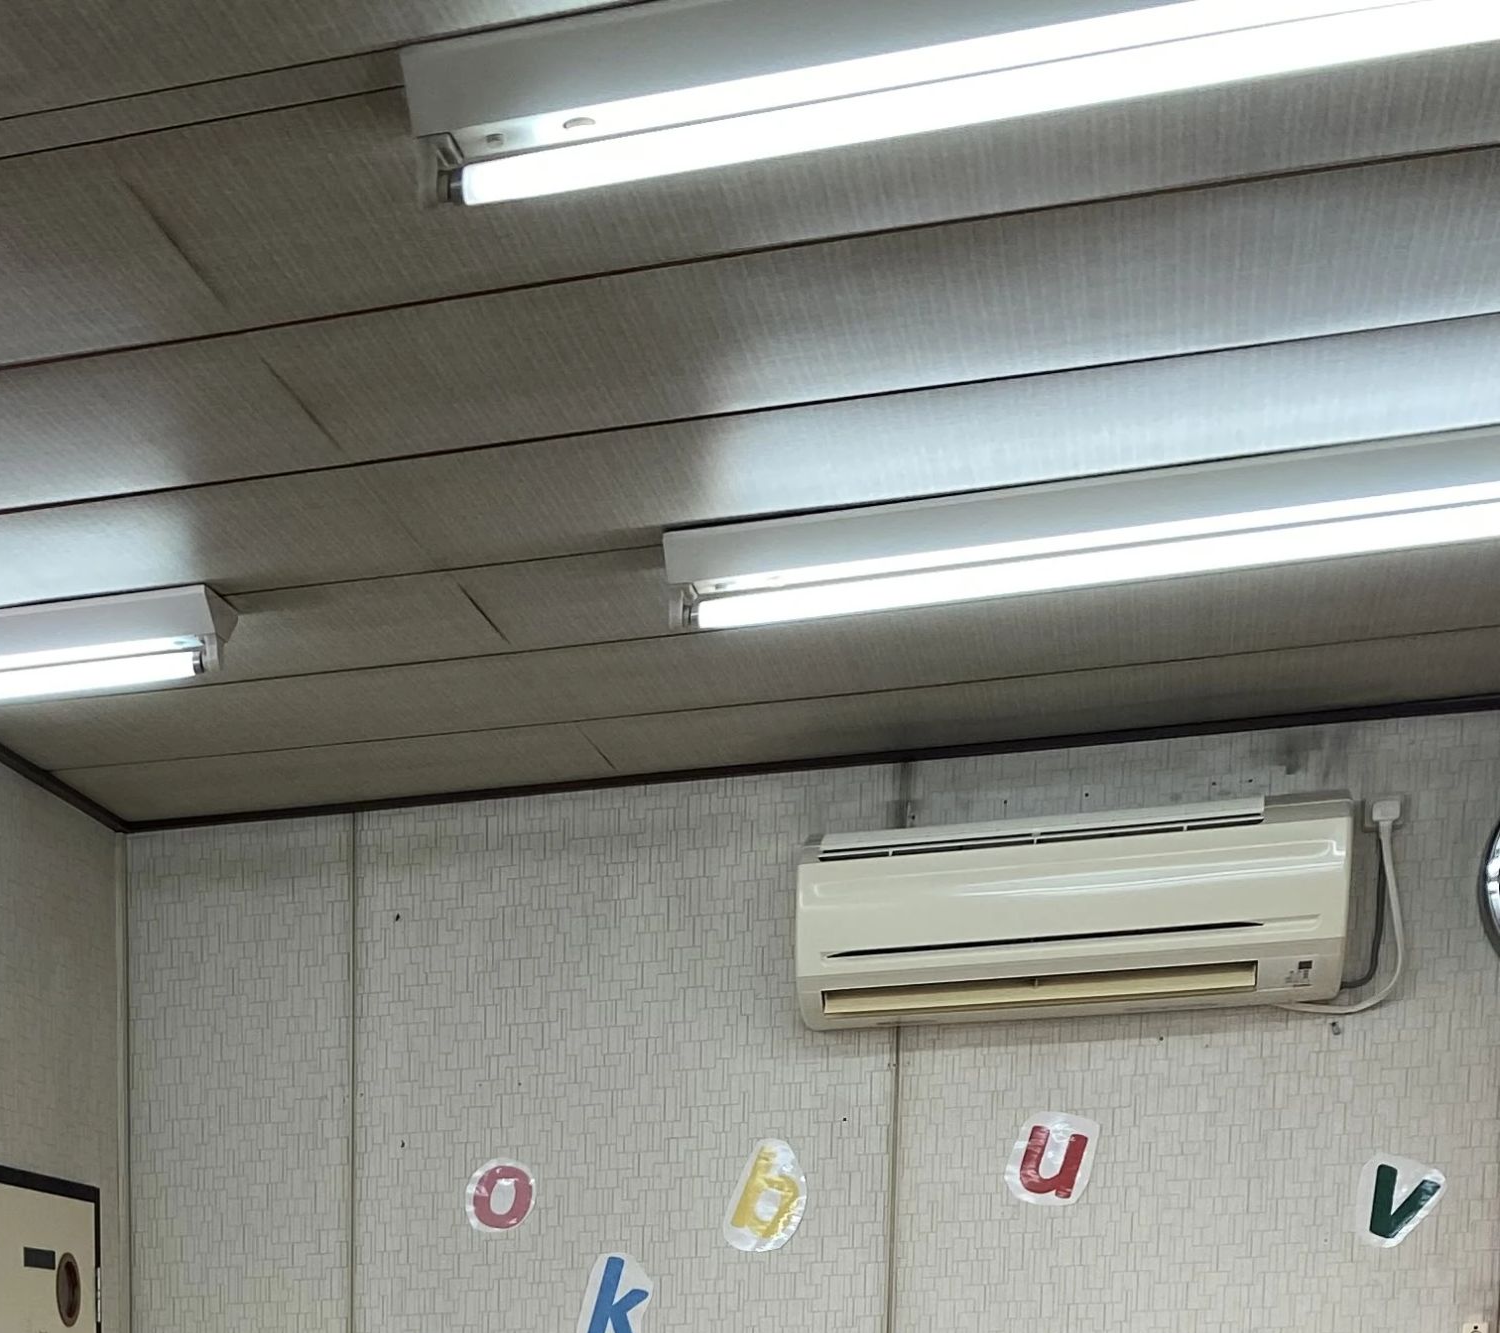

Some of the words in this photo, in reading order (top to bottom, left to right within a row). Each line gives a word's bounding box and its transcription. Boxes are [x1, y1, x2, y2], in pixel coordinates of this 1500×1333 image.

[474, 1167, 532, 1227] o
[732, 1148, 799, 1239] b
[1020, 1125, 1087, 1198] u
[1370, 1165, 1440, 1238] v
